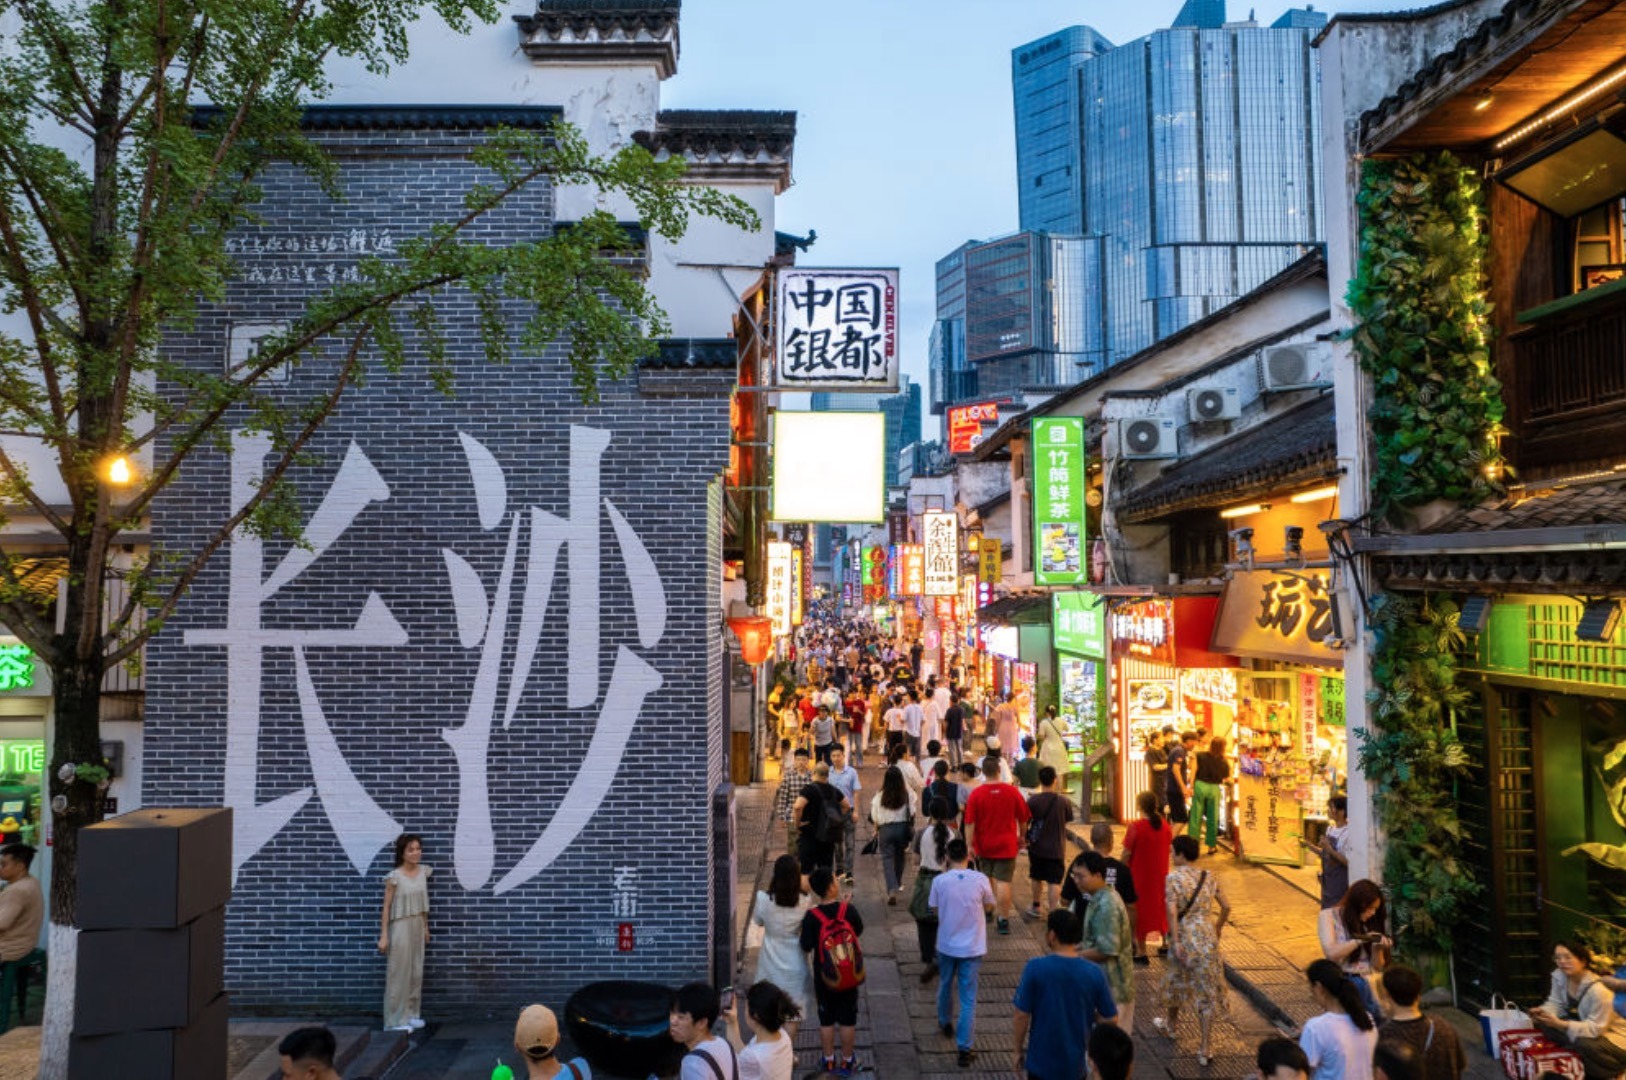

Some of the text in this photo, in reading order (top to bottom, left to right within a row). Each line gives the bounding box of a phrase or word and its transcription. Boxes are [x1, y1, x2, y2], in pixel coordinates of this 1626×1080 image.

[788, 279, 881, 330] 中国
[786, 325, 882, 376] 银都
[184, 424, 667, 897] 长沙
